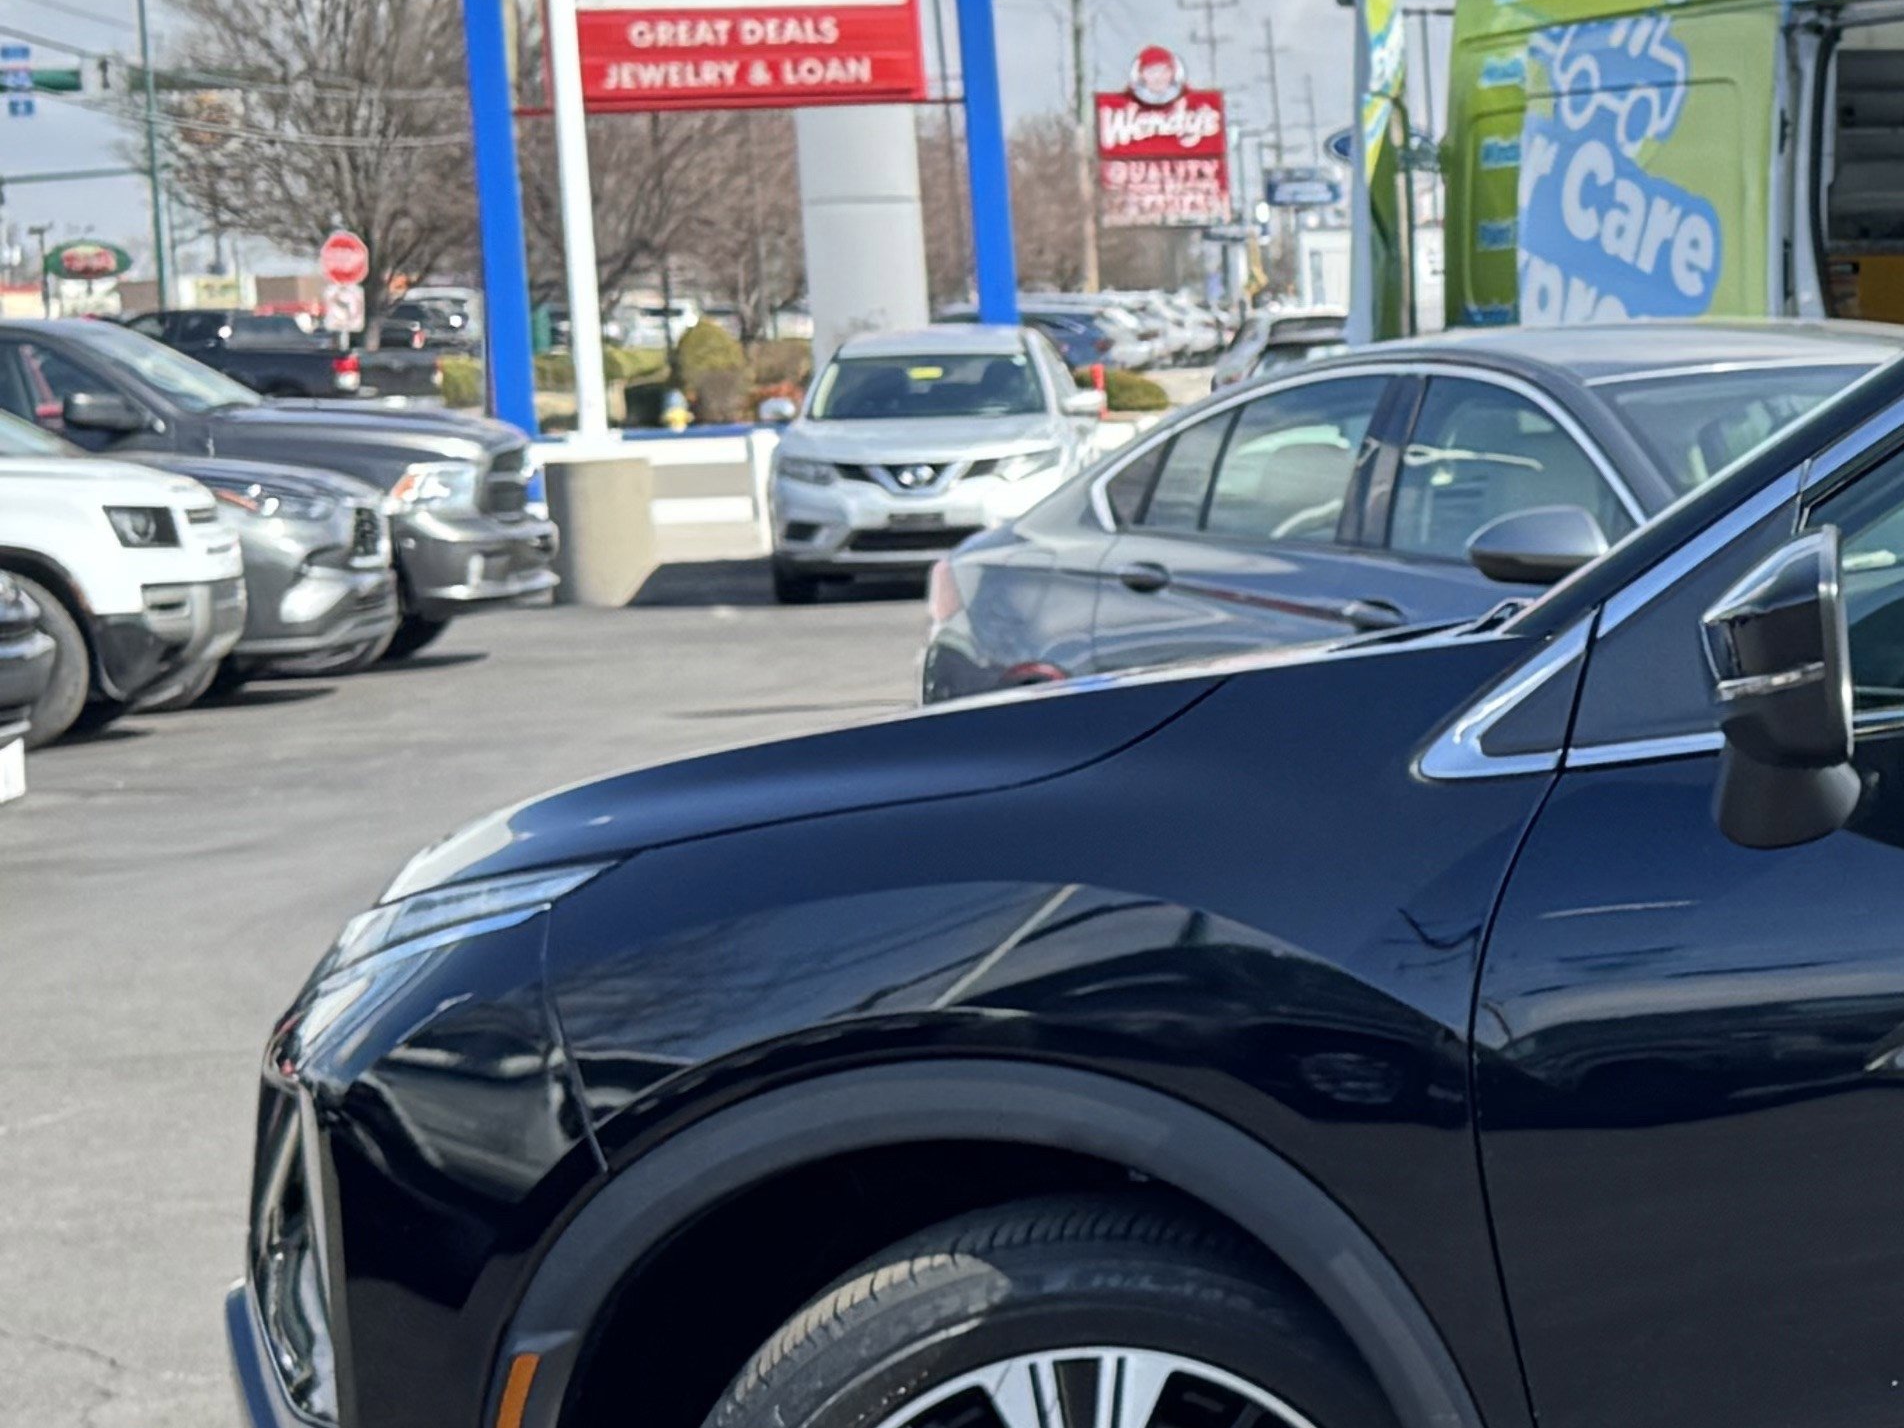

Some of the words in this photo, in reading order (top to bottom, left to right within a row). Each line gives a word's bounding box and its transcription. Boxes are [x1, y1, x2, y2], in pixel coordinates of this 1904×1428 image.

[628, 18, 731, 48] GREAT
[738, 16, 839, 46] DEALS
[603, 60, 739, 90] JEWELRY
[748, 59, 772, 86] &
[783, 56, 872, 85] LOAN
[1561, 140, 1715, 298] Care
